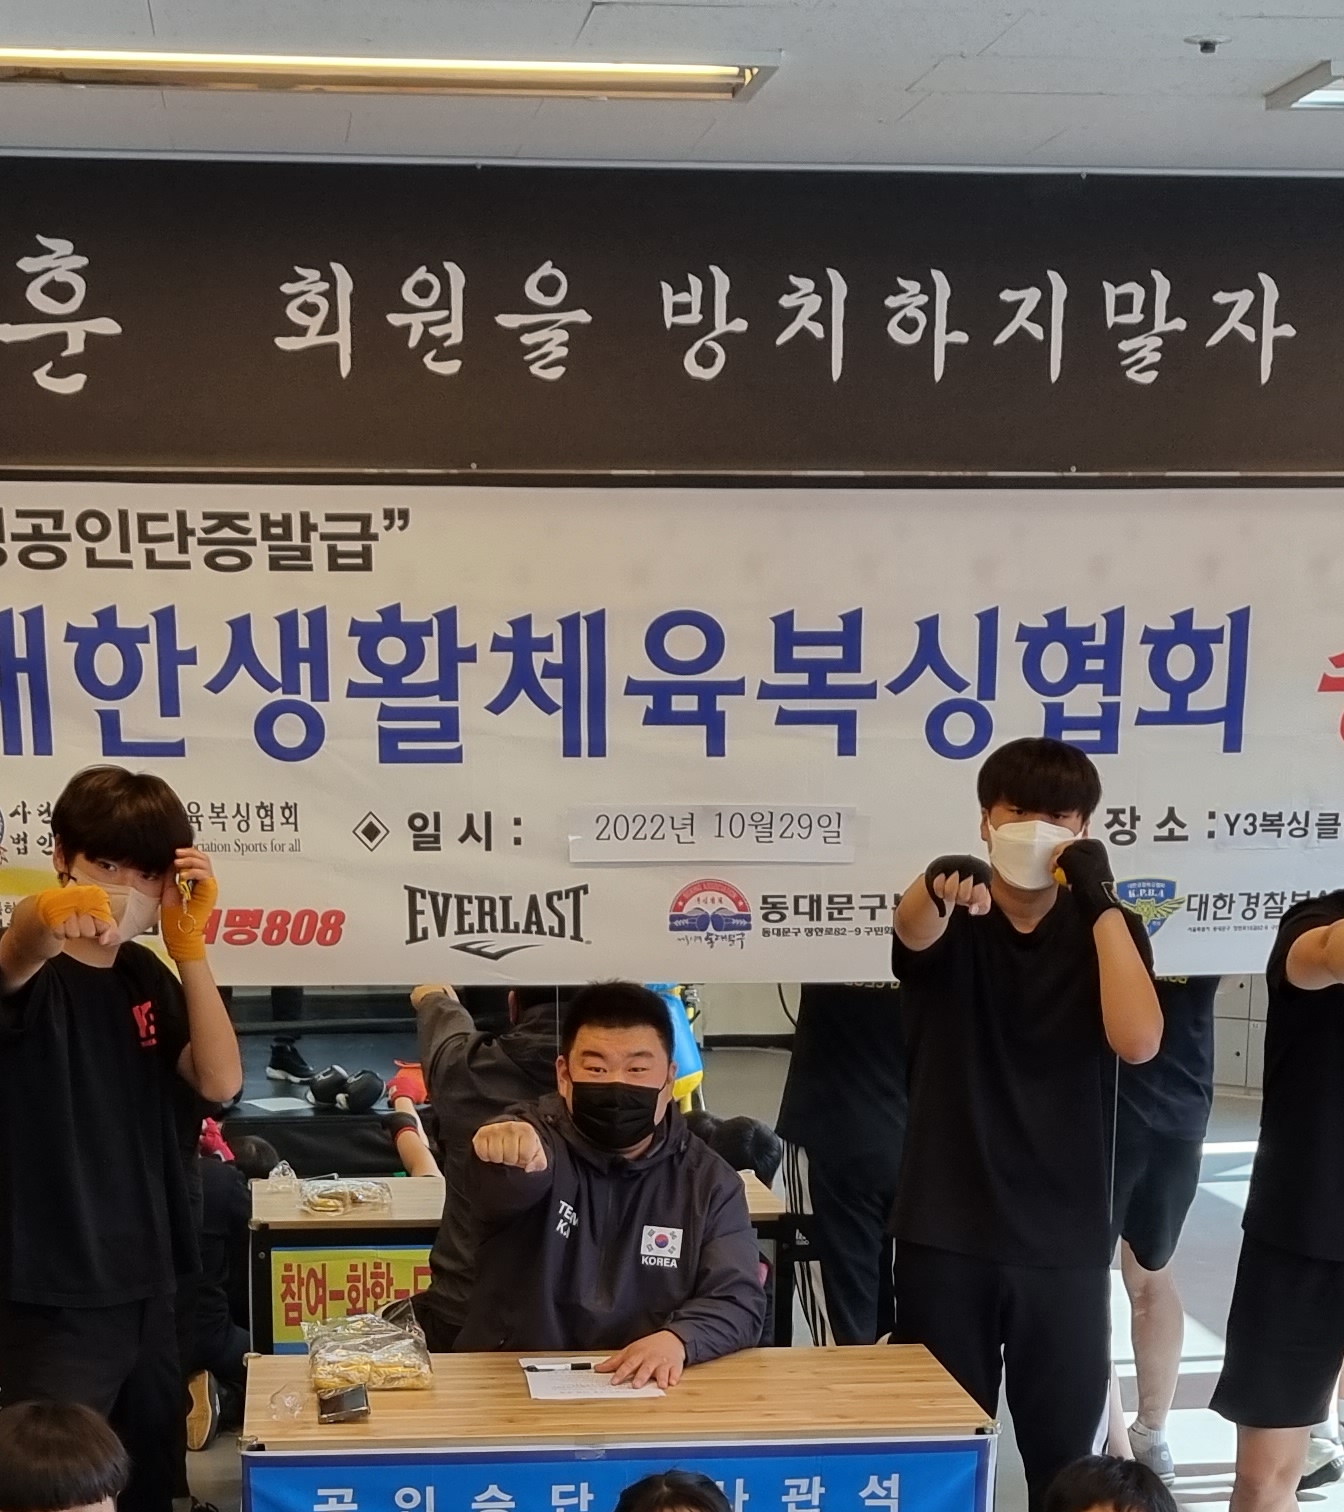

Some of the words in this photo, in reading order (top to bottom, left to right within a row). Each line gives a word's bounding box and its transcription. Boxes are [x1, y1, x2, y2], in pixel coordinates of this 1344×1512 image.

[273, 260, 592, 380] 회원을
[660, 264, 1297, 386] 방치하지말자
[234, 838, 267, 855] Sports
[270, 838, 286, 852] for
[289, 838, 301, 852] all
[594, 812, 697, 845] 2022년
[713, 810, 843, 847] 10월29일
[403, 882, 593, 946] EVERLAST
[641, 1255, 678, 1268] KOREA
